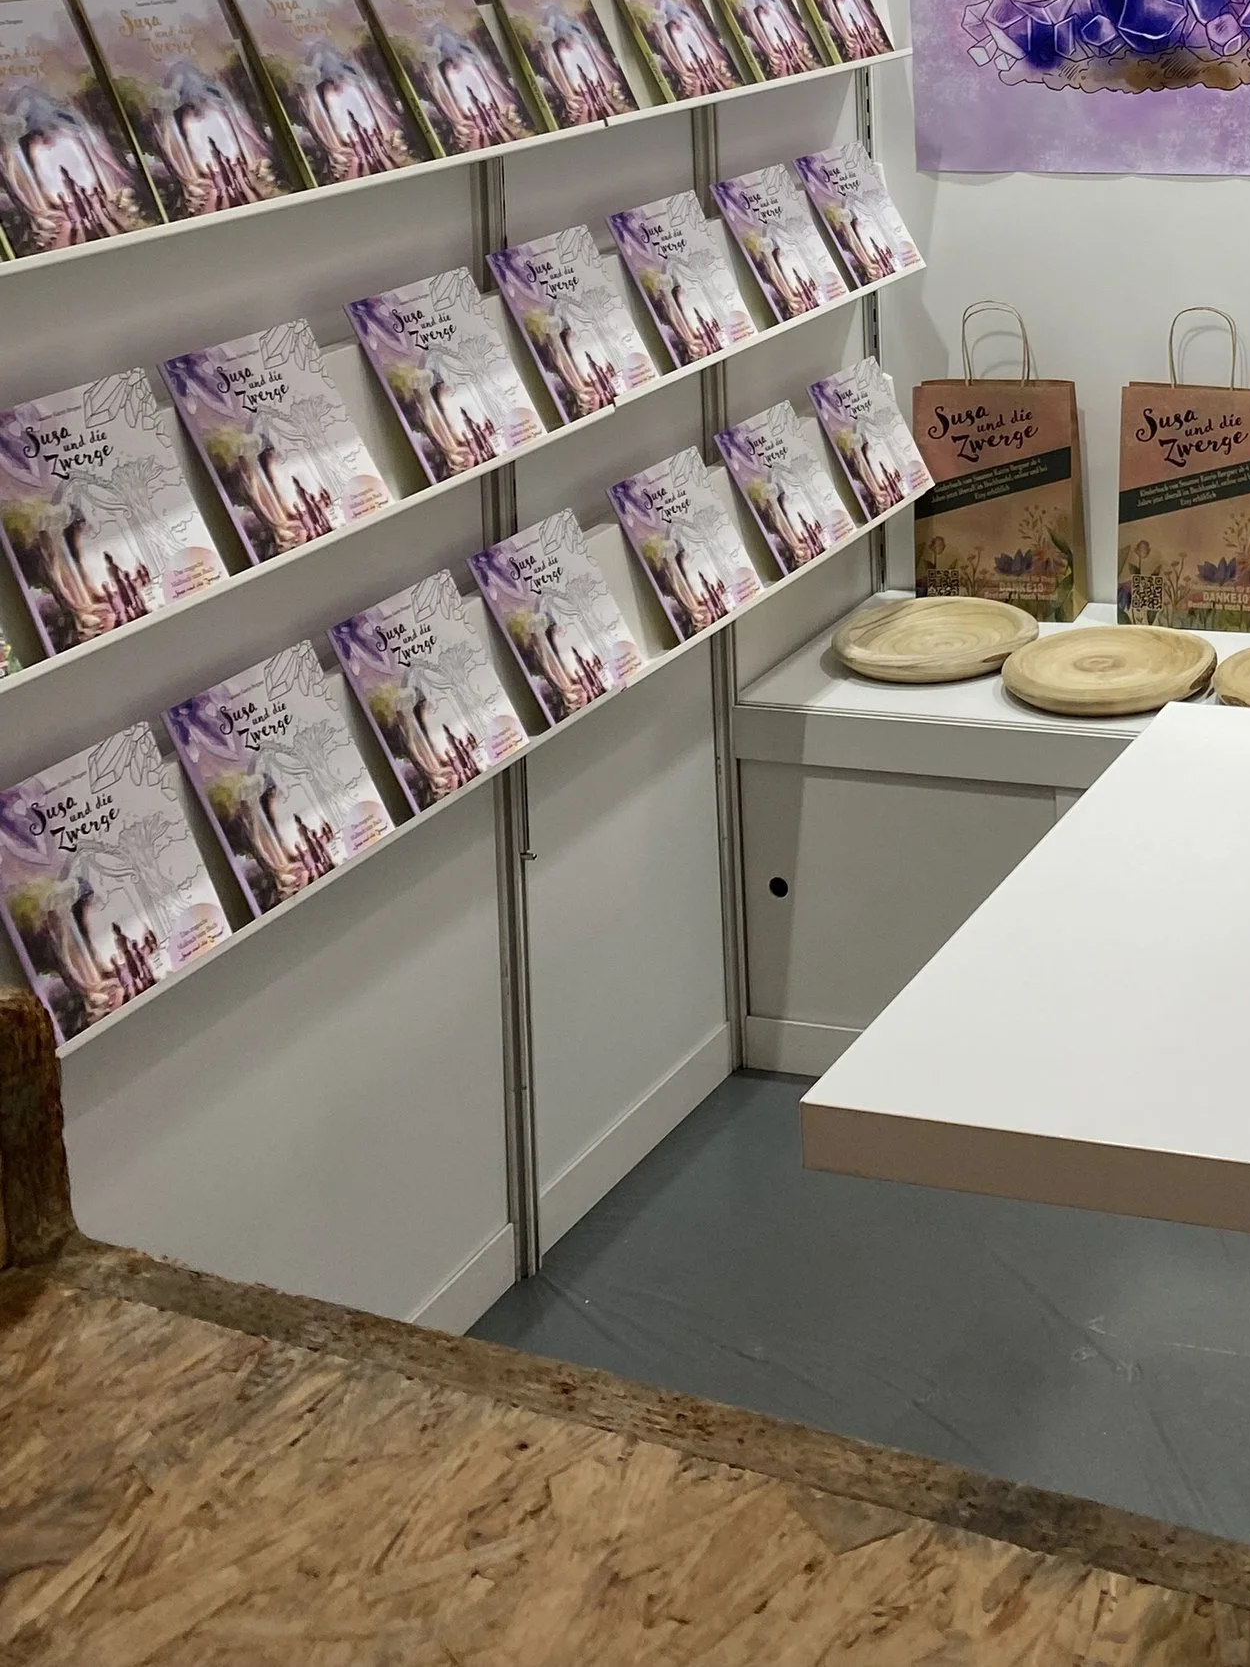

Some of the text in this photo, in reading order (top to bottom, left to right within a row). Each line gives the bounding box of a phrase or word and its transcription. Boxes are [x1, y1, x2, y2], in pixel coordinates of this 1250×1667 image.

[740, 191, 762, 210] Susa
[640, 223, 664, 243] Susa
[651, 238, 687, 259] Zwerge
[526, 260, 553, 283] Susa
[538, 276, 579, 300] Zwerge
[392, 309, 425, 333] Susa
[407, 324, 457, 351] Zwerge
[216, 366, 254, 393] Susa
[248, 370, 282, 389] und die
[233, 384, 289, 413] Zwerge
[927, 405, 989, 439] Susa
[976, 408, 1033, 433] und die
[1135, 408, 1198, 442] Susa
[1184, 413, 1242, 437] und die
[23, 426, 72, 458] Susa
[63, 429, 107, 452] und die
[745, 436, 767, 455] Susa
[950, 425, 1038, 462] Zwerge
[1158, 431, 1248, 467] Zwerge
[42, 444, 113, 480] Zwerge
[643, 487, 668, 510] Susa
[654, 498, 691, 524] Zwerge
[509, 555, 537, 580] Susa
[522, 566, 563, 595] Zwerge
[1203, 592, 1248, 603] DANKE10
[375, 623, 407, 652] Susa
[389, 635, 437, 667] Zwerge
[219, 702, 258, 735] Susa
[252, 701, 286, 725] und die
[236, 714, 293, 751] Zwerge
[29, 796, 77, 835] Susa
[69, 793, 113, 823] und die
[49, 808, 120, 852] Zwerge
